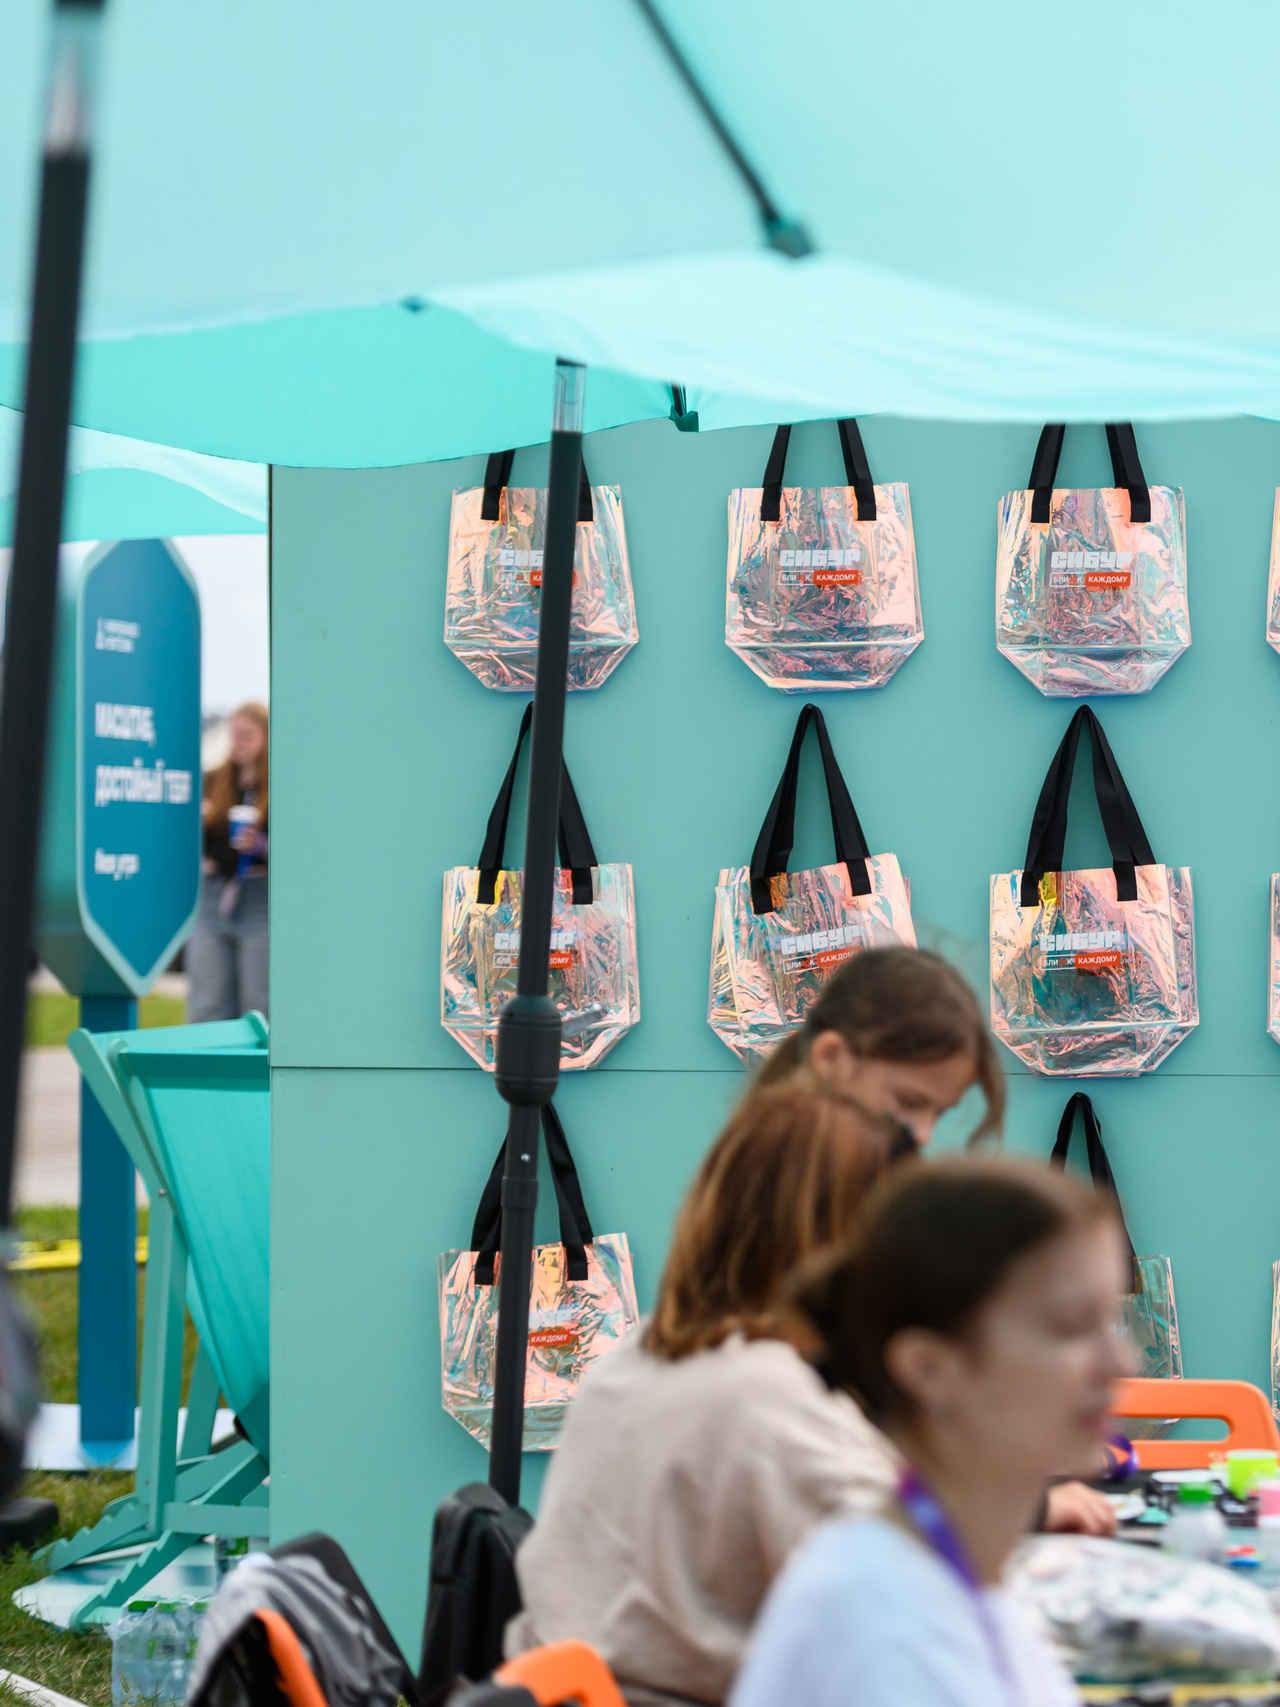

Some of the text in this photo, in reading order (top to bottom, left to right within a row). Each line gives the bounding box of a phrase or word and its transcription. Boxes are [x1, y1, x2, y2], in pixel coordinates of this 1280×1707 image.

[780, 549, 860, 566] СИБУР
[1051, 551, 1133, 568] СИБУР
[816, 573, 856, 582] КАЖДОМУ
[781, 925, 860, 956] СИБУР
[1040, 930, 1121, 952] СИБУР
[1043, 955, 1118, 966] БЛИЗОК КАЖДОМУ
[531, 1334, 568, 1343] КАЖДОМУ
